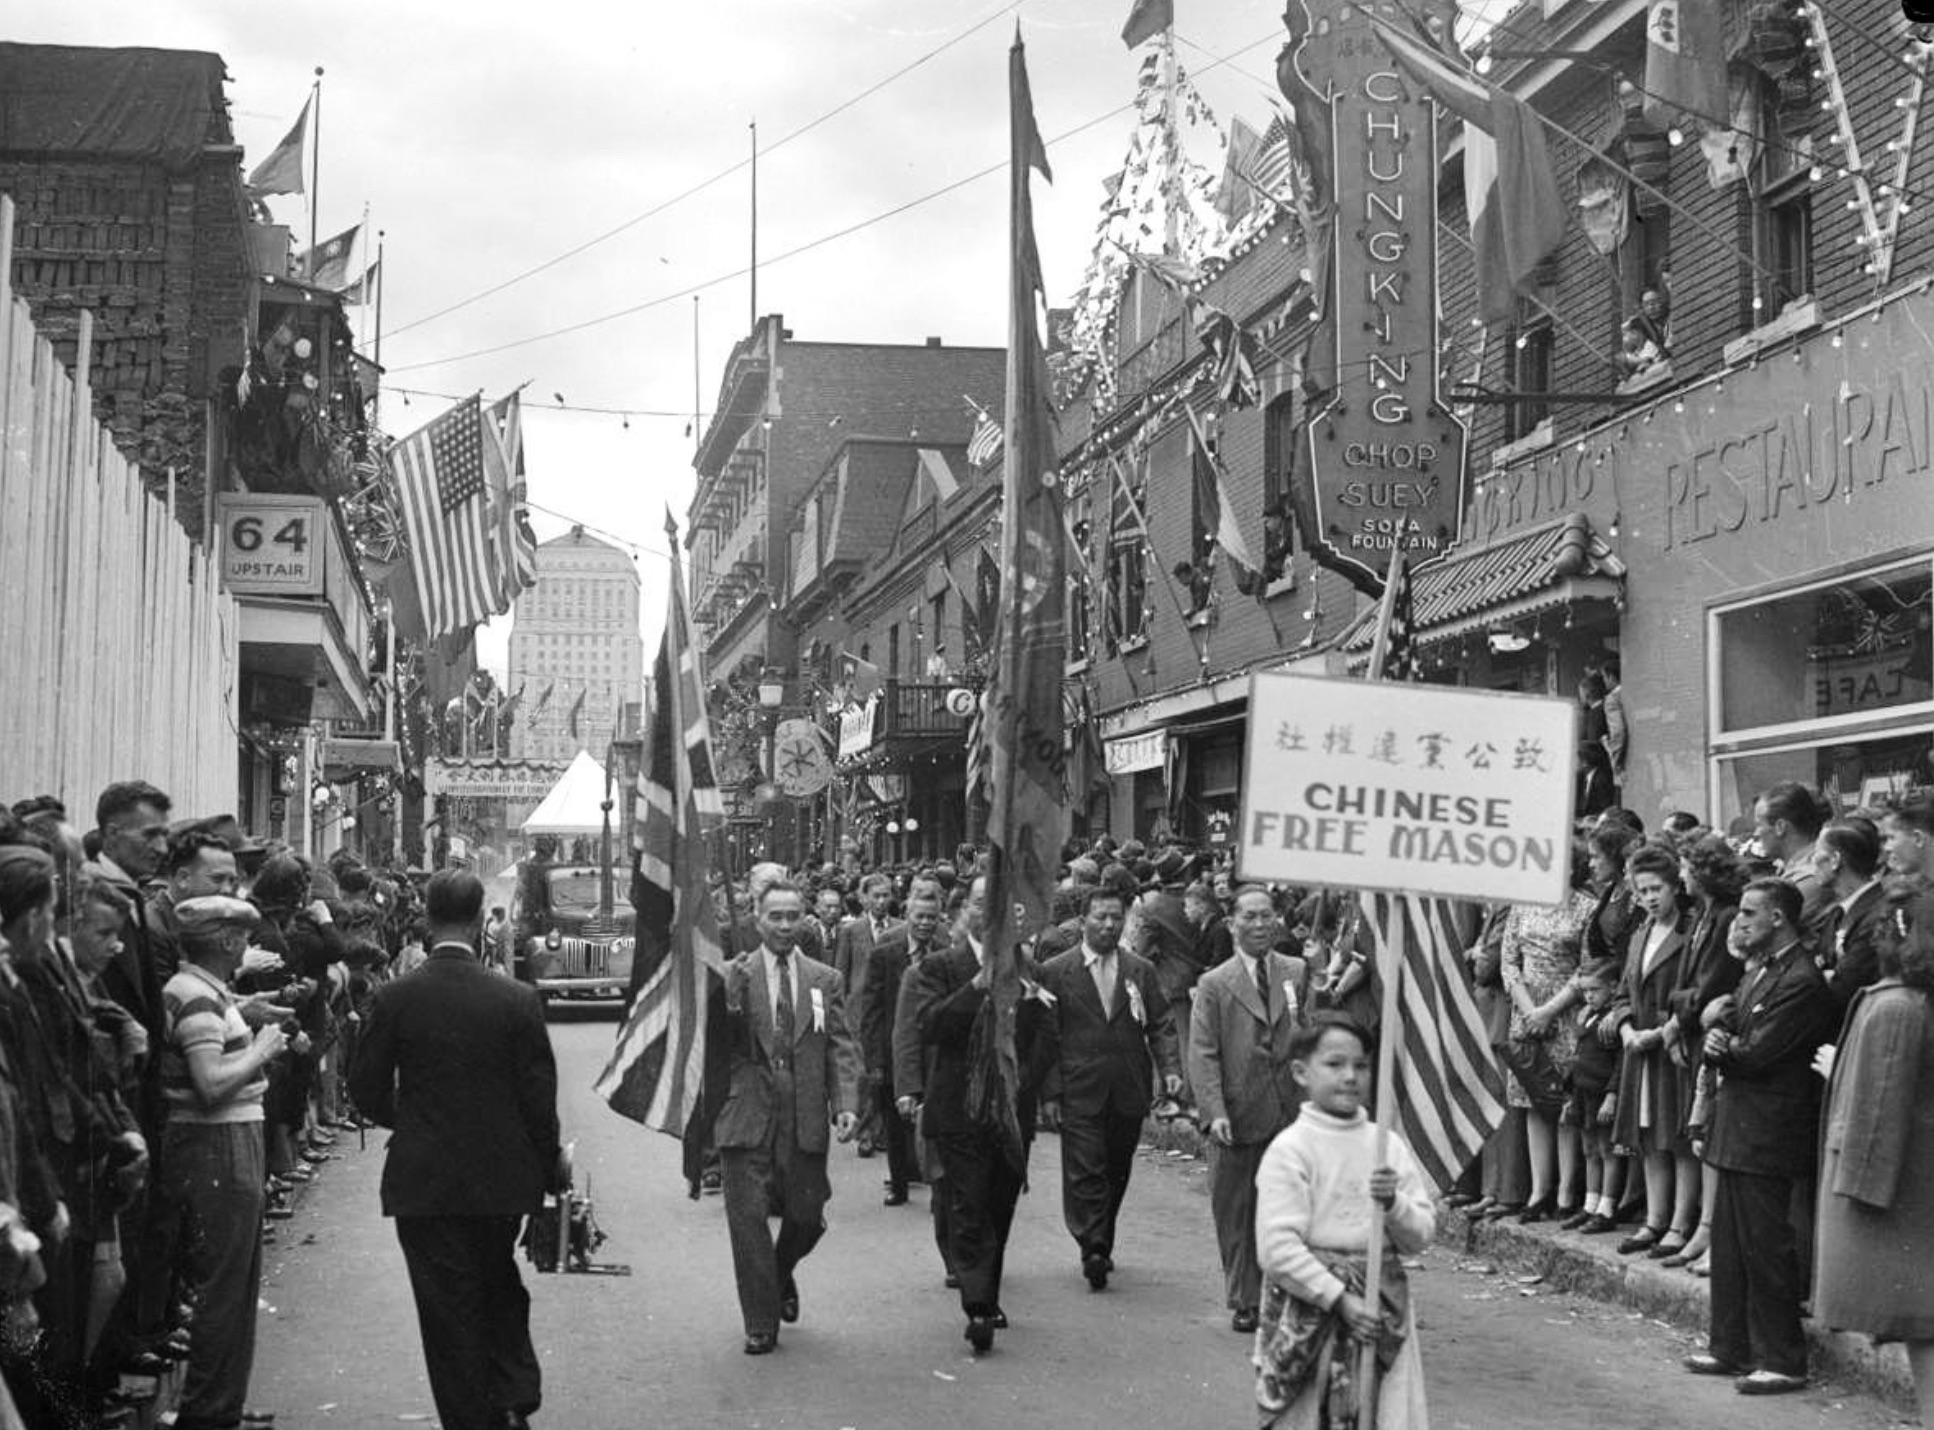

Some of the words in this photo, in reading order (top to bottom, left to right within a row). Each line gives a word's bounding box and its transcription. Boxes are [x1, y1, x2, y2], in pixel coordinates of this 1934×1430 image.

[1365, 71, 1408, 423] CHUNGKING
[1344, 442, 1437, 468] CHOP
[1340, 483, 1436, 507] SUEY
[232, 516, 307, 552] 64
[1352, 535, 1437, 549] FOUNAIN
[232, 562, 304, 576] UPSTAIR
[1304, 782, 1512, 828] CHINESE
[1252, 811, 1369, 856] FREE
[1389, 823, 1554, 873] MASON
